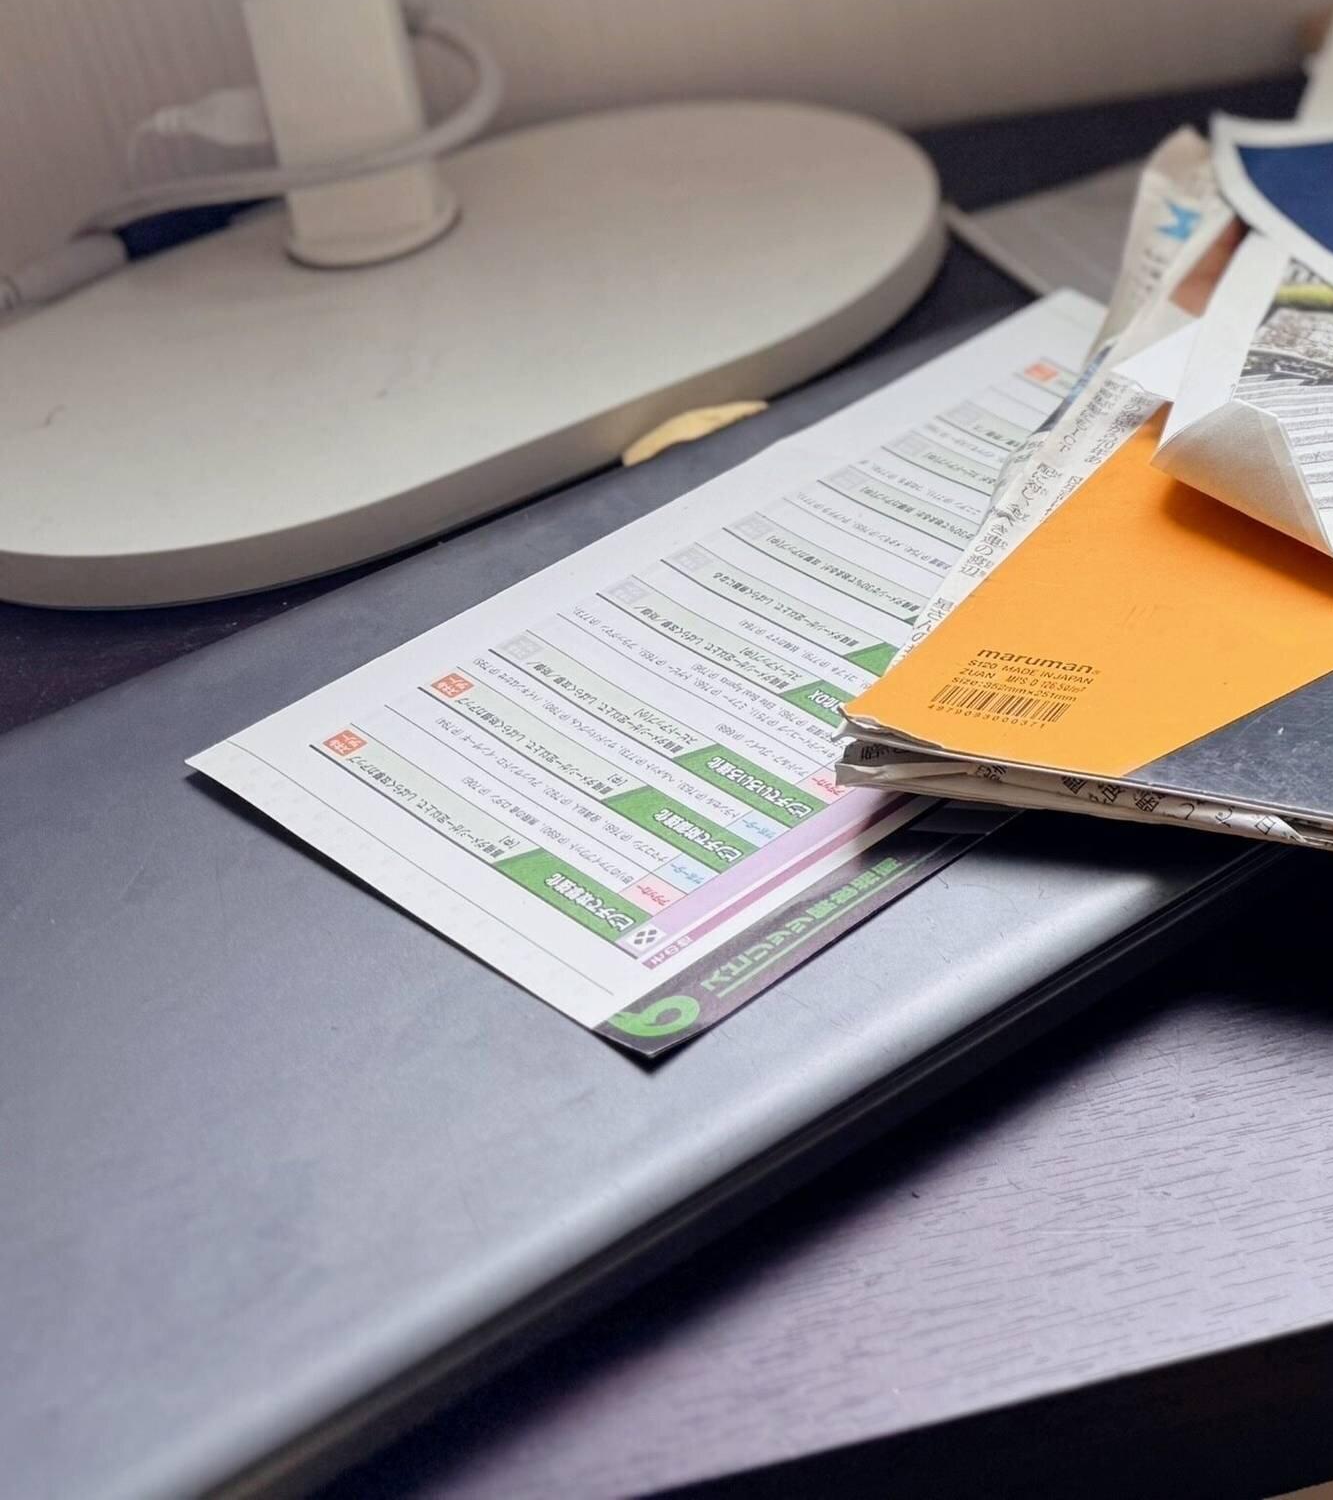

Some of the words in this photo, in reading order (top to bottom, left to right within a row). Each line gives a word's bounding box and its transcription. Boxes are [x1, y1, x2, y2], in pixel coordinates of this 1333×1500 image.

[959, 667, 996, 680] ZUAN
[968, 659, 998, 670] S120
[1001, 664, 1037, 677] MADE
[1052, 672, 1095, 686] JAPAN
[976, 649, 1094, 675] maruman
[704, 755, 813, 817] ピンチでいろいろ強化
[651, 808, 744, 862] ピンチで防御強化
[541, 872, 636, 930] ピンチで攻撃強化
